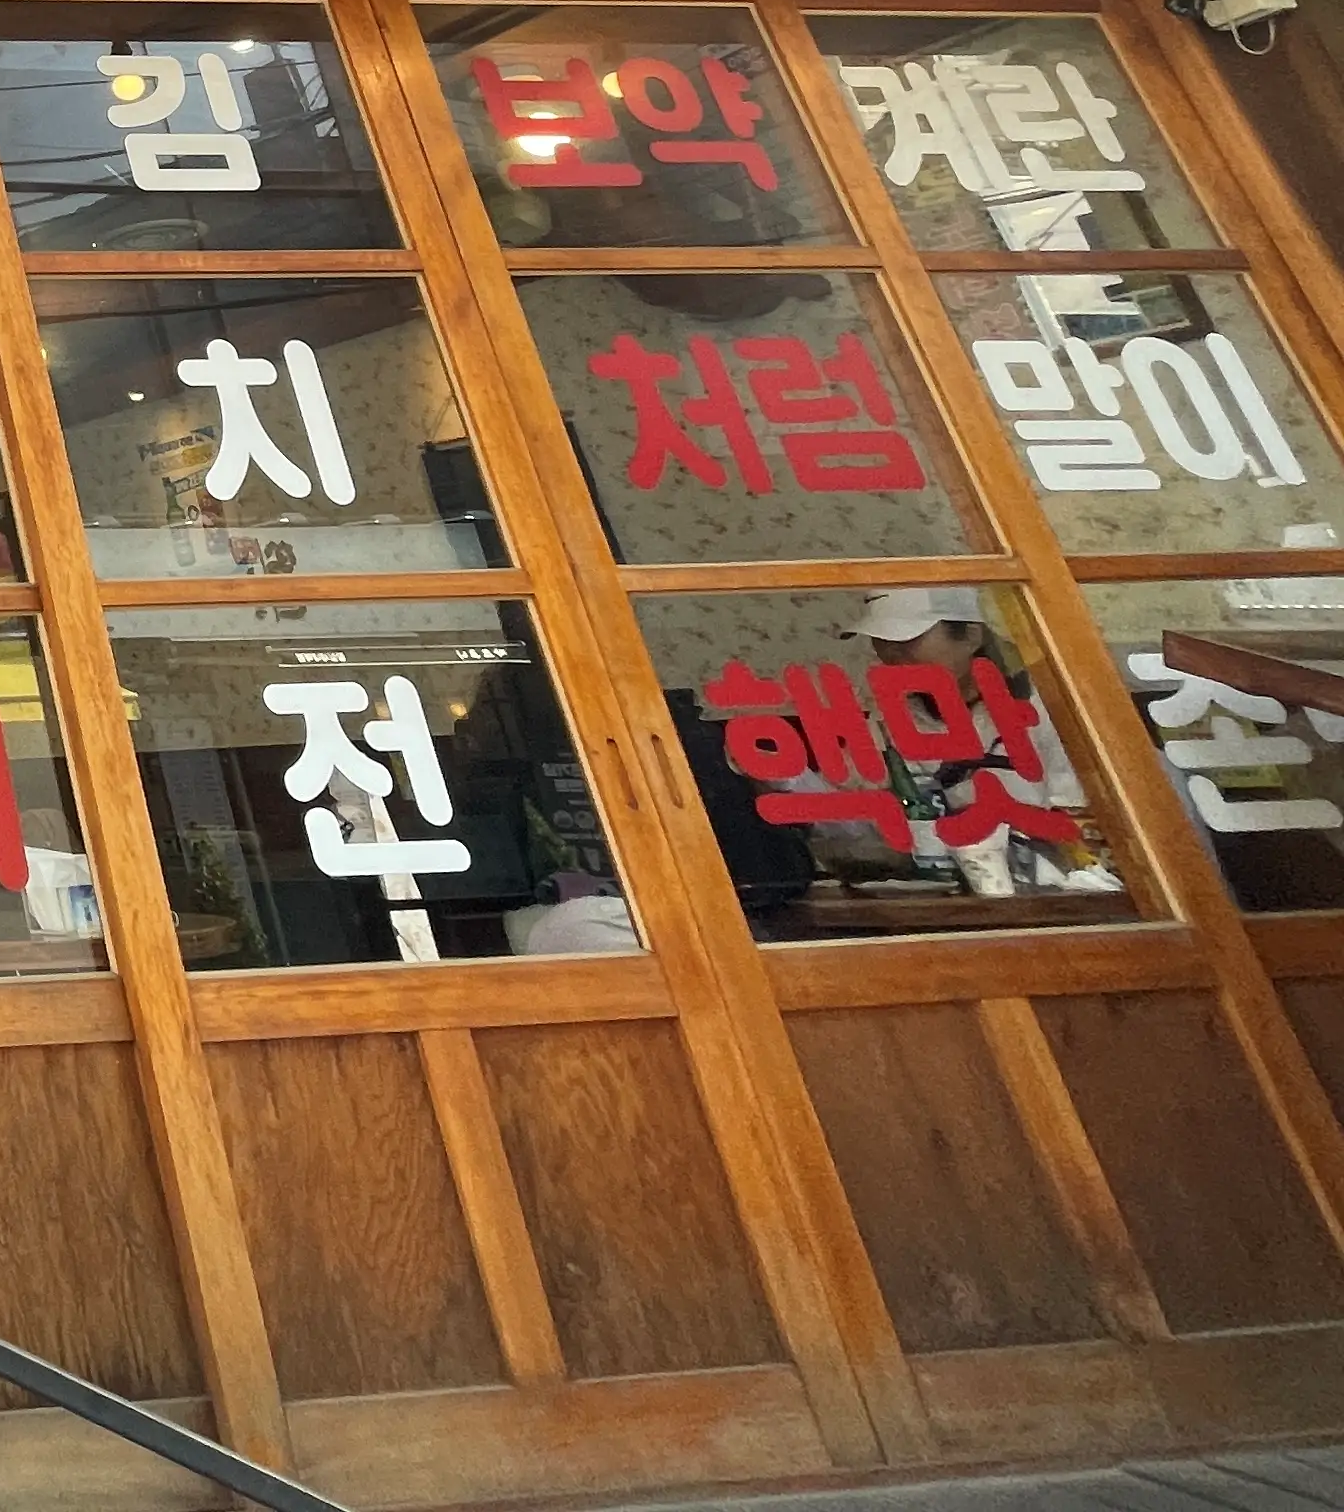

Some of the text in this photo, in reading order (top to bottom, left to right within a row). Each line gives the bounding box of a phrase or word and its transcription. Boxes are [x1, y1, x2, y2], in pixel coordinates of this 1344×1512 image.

[470, 55, 778, 192] 보약
[838, 60, 1147, 193] 계란
[96, 52, 472, 877] 김 치 전
[588, 329, 928, 495] 처럼
[971, 332, 1308, 492] 말이
[703, 656, 1083, 854] 핵맛
[1127, 652, 1344, 833] 존
